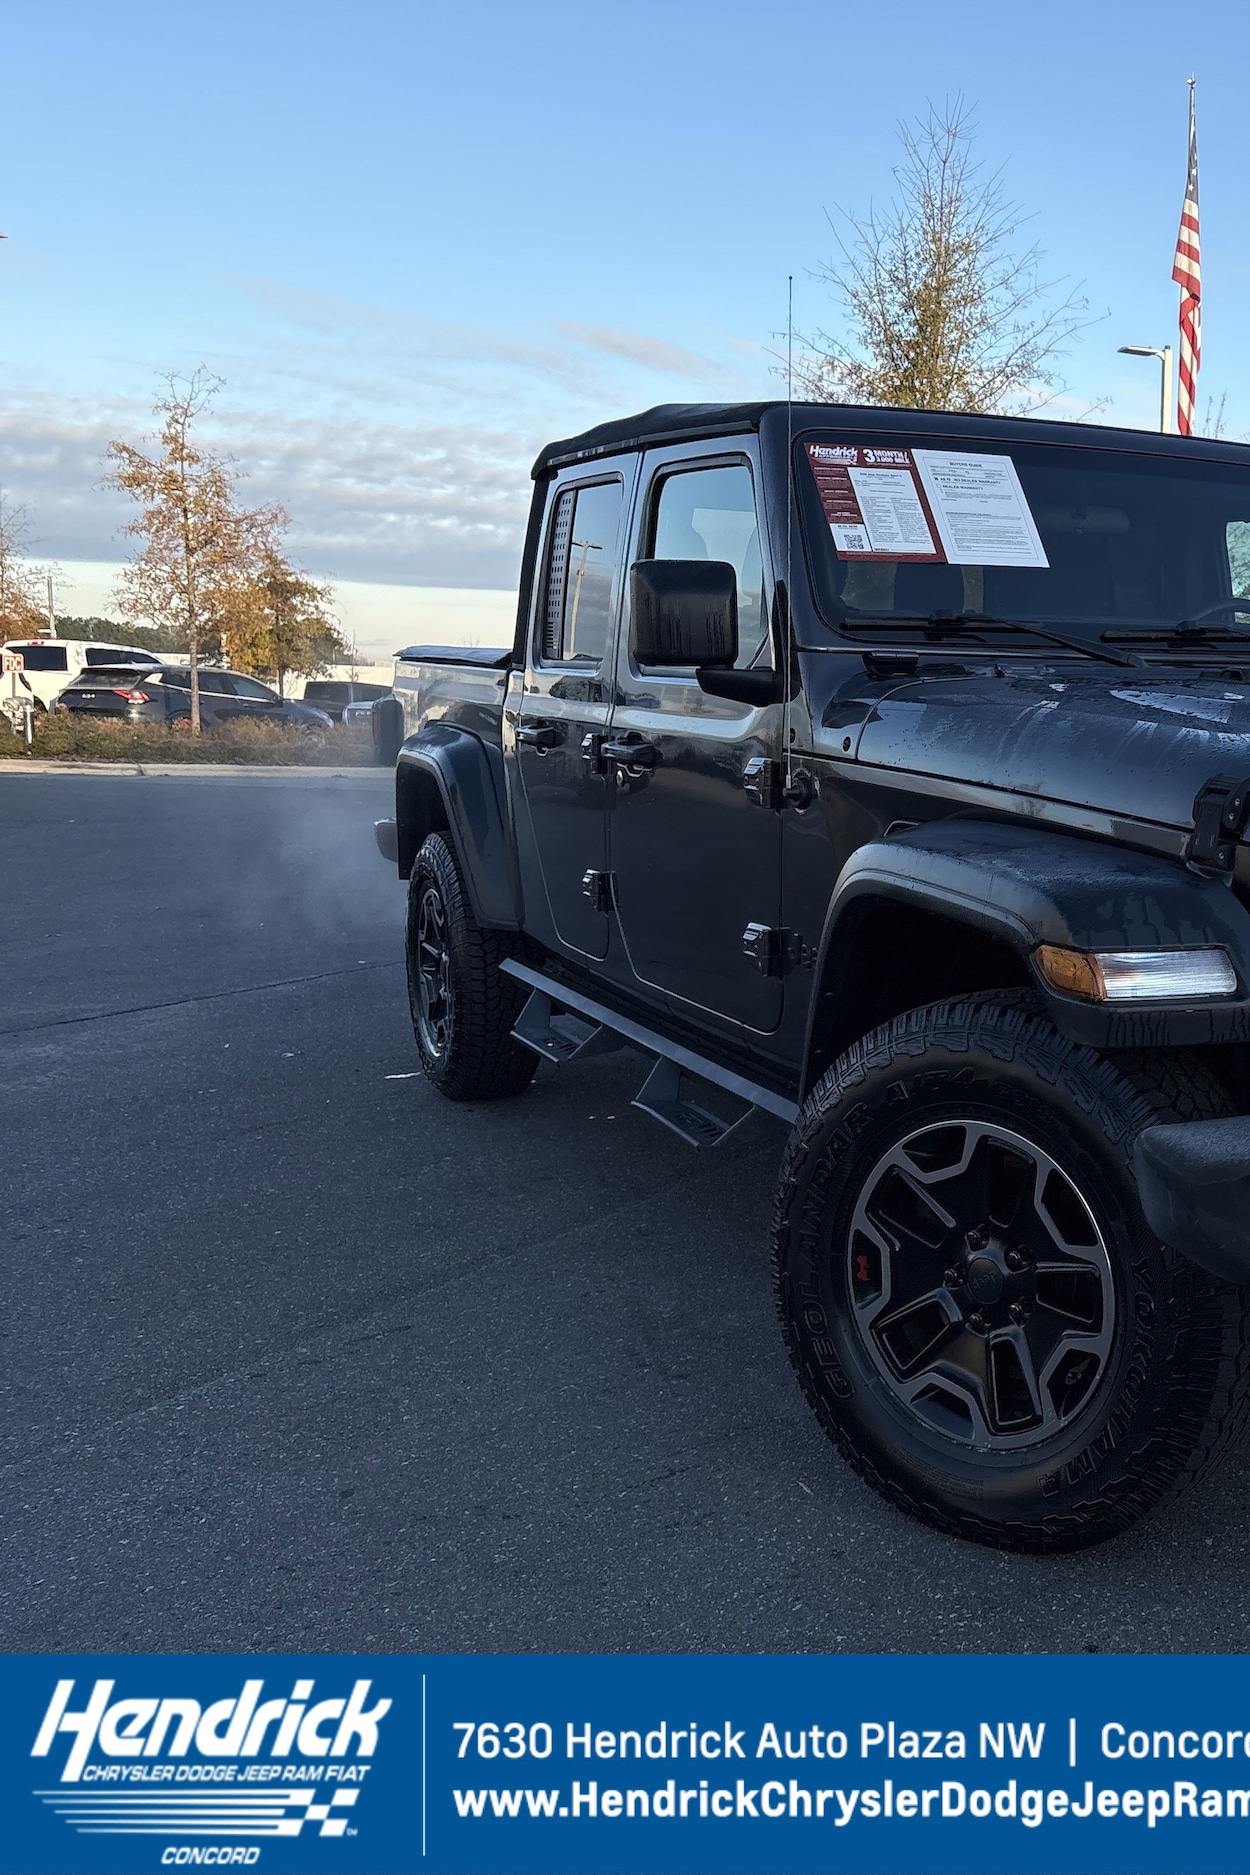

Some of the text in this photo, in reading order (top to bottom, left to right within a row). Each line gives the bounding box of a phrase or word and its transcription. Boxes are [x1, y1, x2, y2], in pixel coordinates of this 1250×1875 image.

[809, 445, 858, 458] Hendrick
[863, 449, 876, 463] 3
[5, 655, 22, 671] FDC
